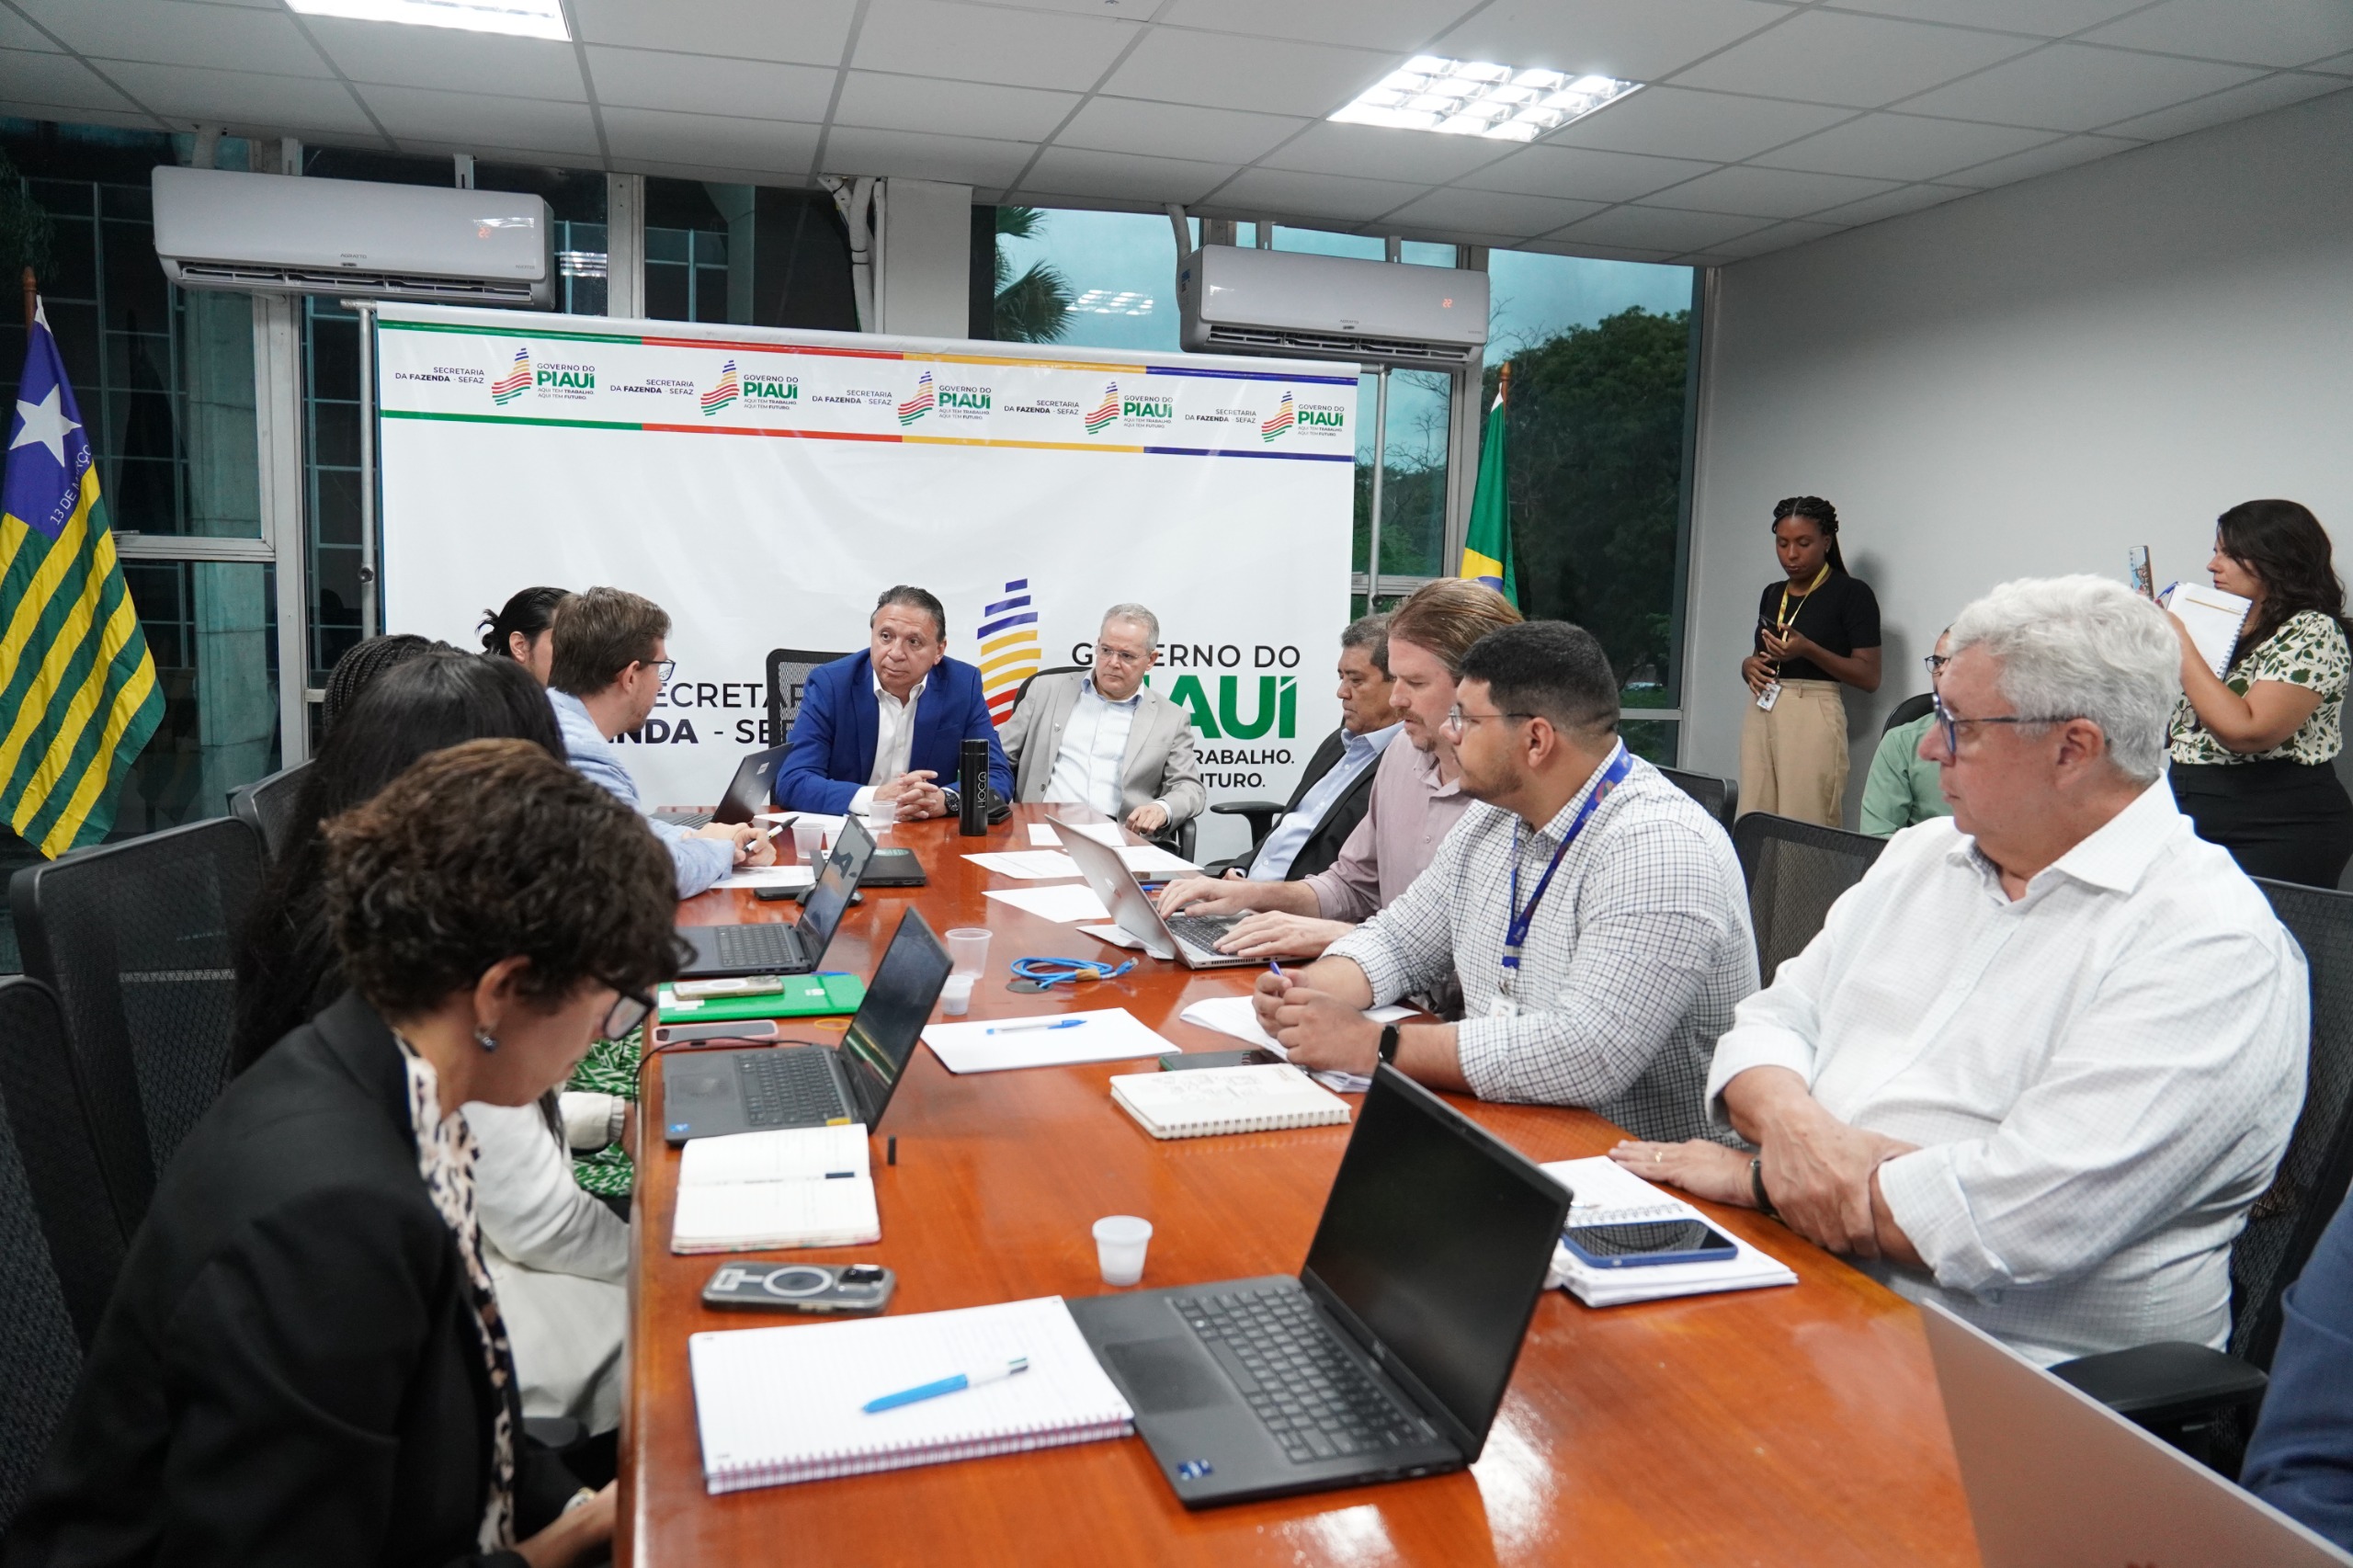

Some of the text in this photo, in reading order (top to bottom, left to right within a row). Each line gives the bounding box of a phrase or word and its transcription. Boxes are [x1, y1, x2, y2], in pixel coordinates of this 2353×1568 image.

[433, 367, 484, 376] SECRETARIA
[537, 363, 580, 371] GOVERNO
[409, 373, 450, 382] FAZENDA
[537, 369, 595, 389] PIAUÍ
[646, 379, 694, 387] SECRETARIA
[744, 374, 784, 382] GOVERNO
[744, 381, 798, 399] PIAUÍ
[847, 390, 892, 398] SECRETARIA
[938, 392, 991, 409] PIAUÍ
[1124, 402, 1173, 418] PIAUÍ
[1298, 411, 1344, 426] PIAUÍ
[50, 508, 64, 526] 13
[59, 489, 77, 510] DE
[1255, 645, 1301, 668] DO
[1143, 675, 1297, 740] AUÍ
[1193, 749, 1295, 764] RABALHO.
[1200, 772, 1266, 788] TURO.
